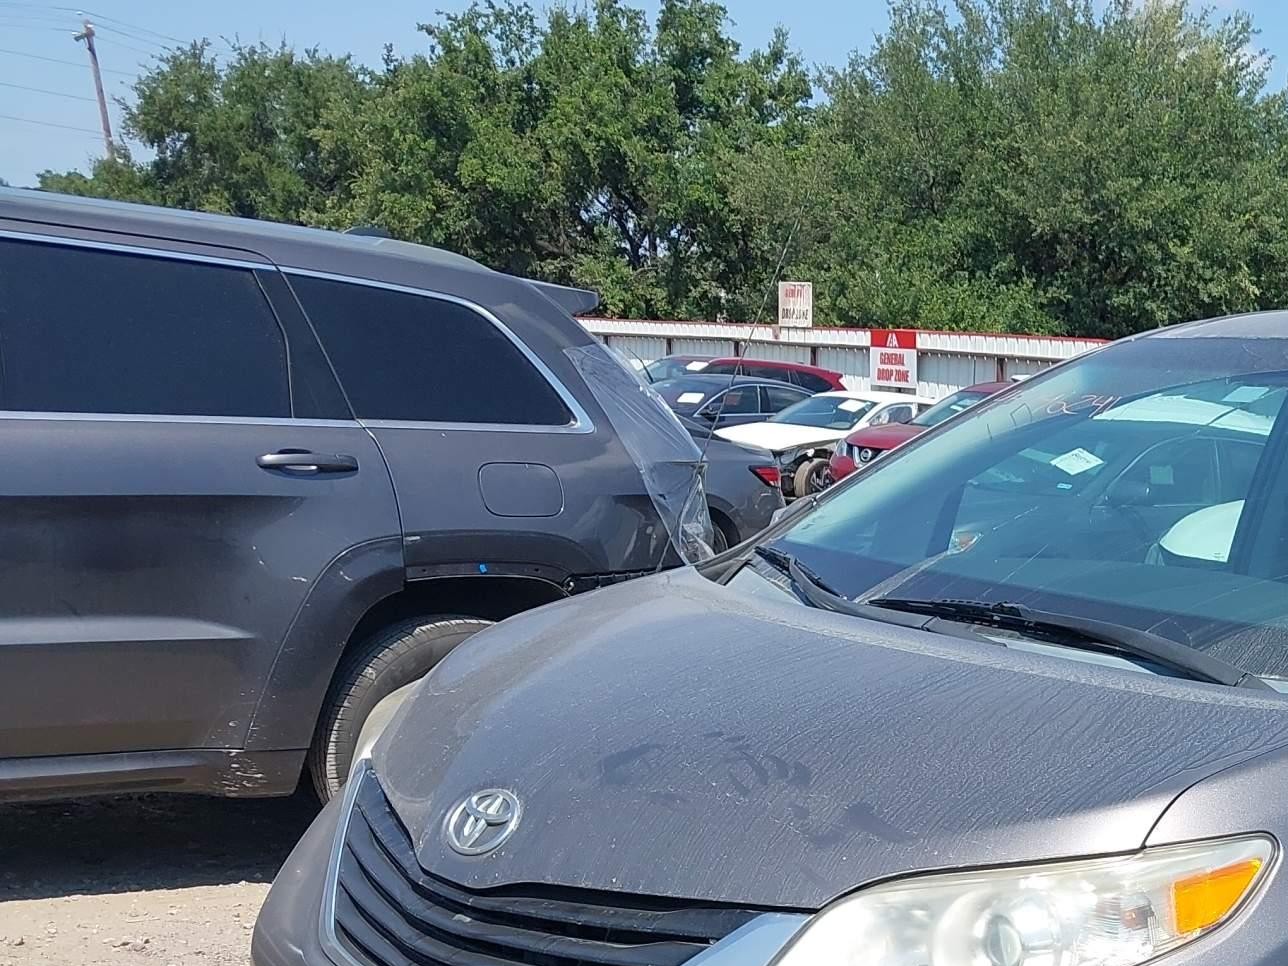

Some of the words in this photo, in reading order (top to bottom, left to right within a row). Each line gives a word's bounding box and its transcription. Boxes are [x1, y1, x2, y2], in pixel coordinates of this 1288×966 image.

[879, 352, 905, 366] GENERAL
[877, 368, 893, 381] DROP
[894, 369, 910, 383] ZONE
